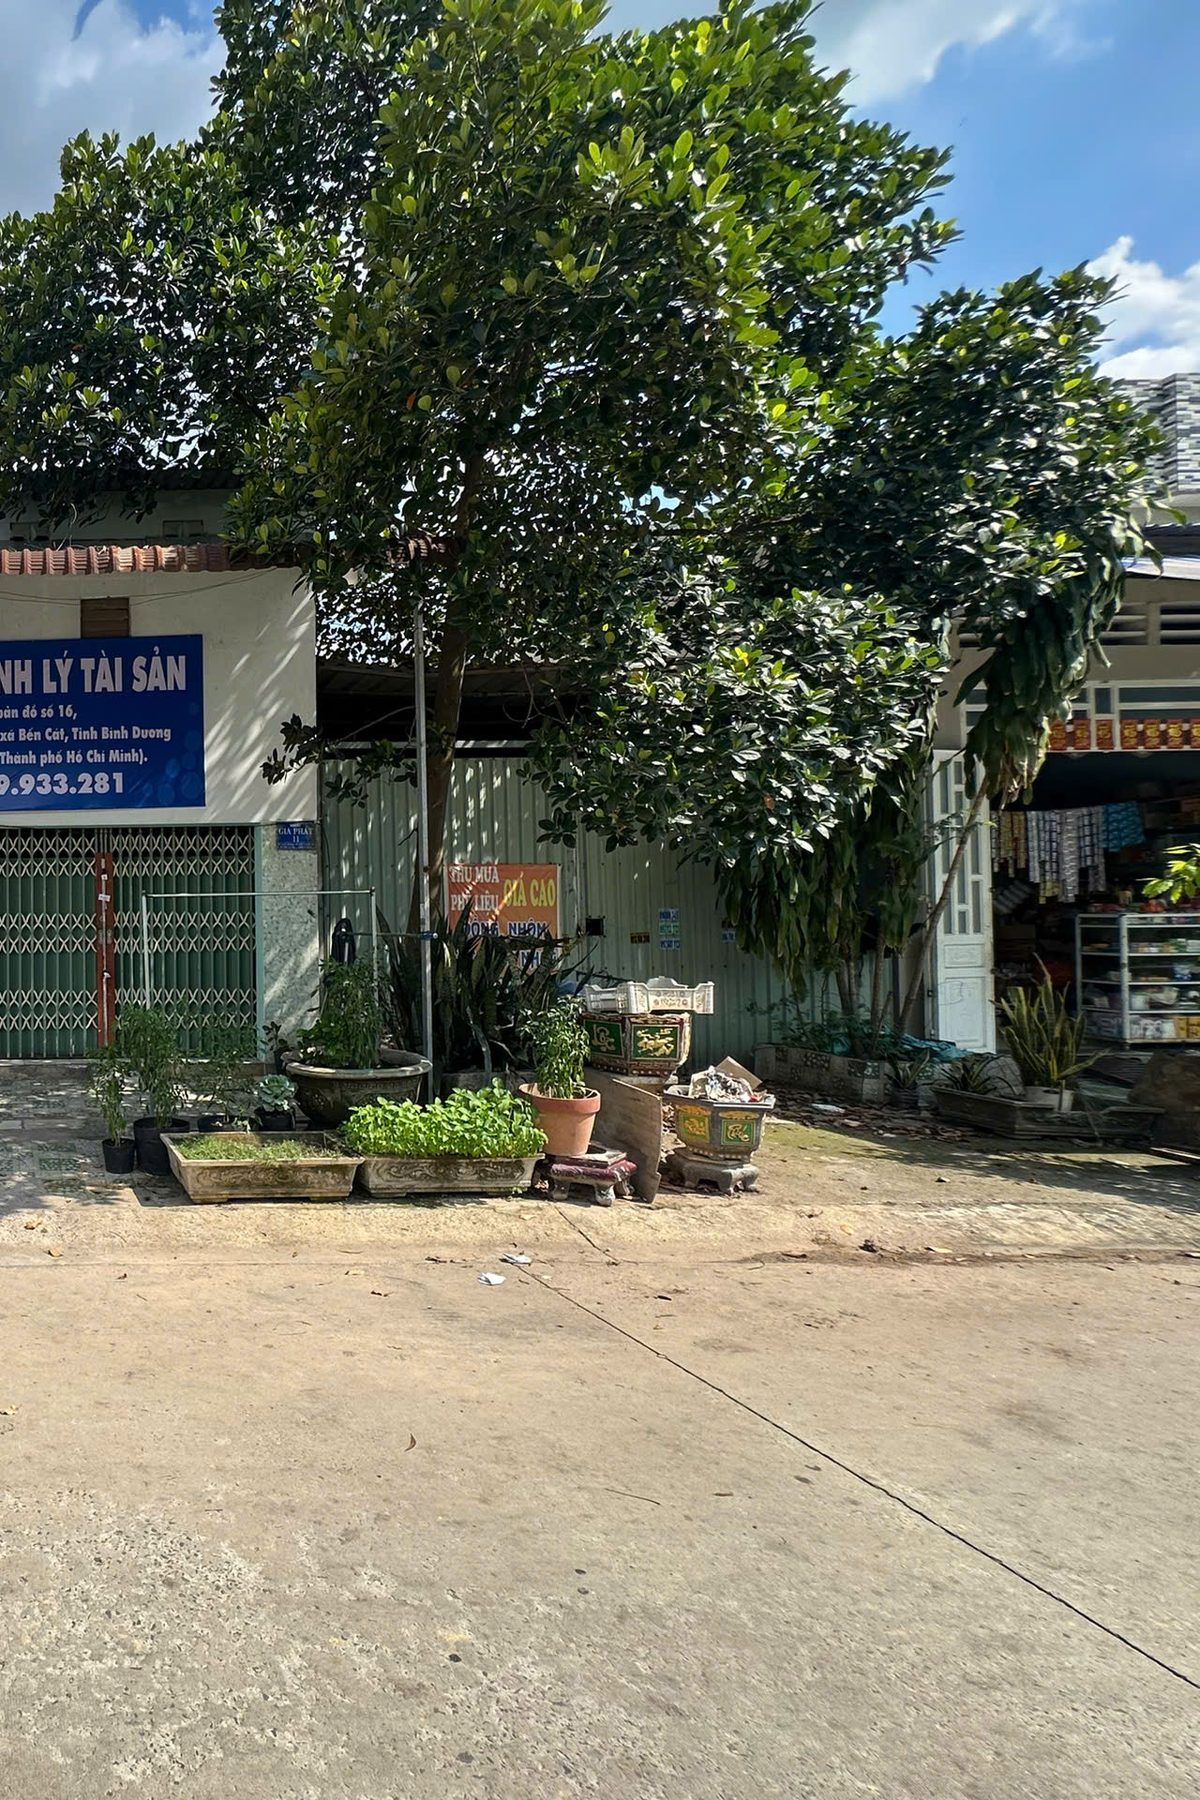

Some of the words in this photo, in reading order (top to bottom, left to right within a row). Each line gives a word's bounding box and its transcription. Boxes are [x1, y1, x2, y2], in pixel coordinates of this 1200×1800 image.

[42, 650, 73, 694] LÝ
[80, 649, 123, 693] TÀI
[132, 646, 186, 692] SẢN
[40, 704, 54, 718] số
[58, 704, 78, 720] 16,
[18, 727, 41, 742] Bến
[44, 727, 69, 743] Cát,
[101, 725, 129, 740] Bình
[132, 726, 172, 742] Dương
[0, 750, 37, 765] Thành
[39, 749, 63, 768] phố
[86, 748, 106, 764] Chí
[108, 748, 148, 766] Minh).
[474, 865, 500, 883] MUA
[503, 871, 528, 907] GIÁ
[529, 879, 556, 907] CAO
